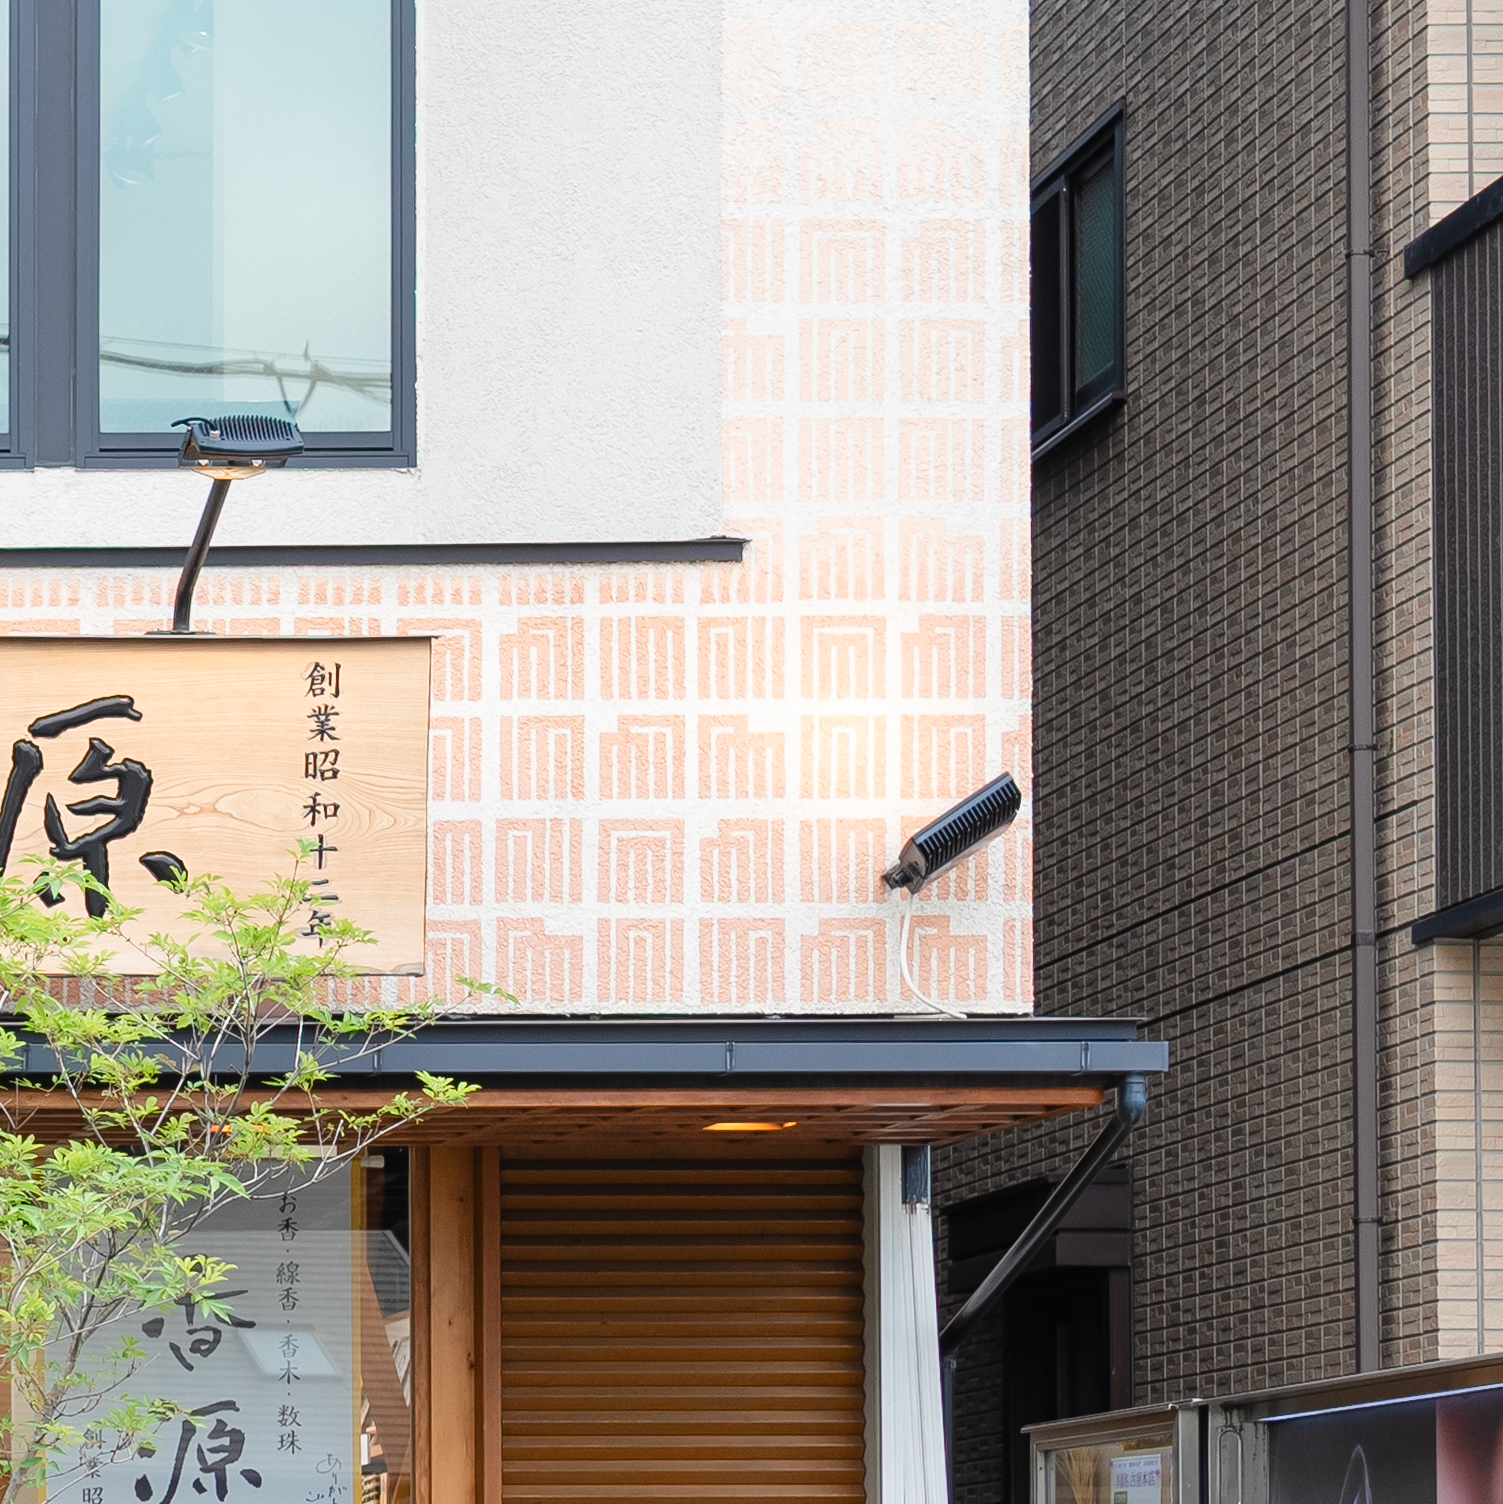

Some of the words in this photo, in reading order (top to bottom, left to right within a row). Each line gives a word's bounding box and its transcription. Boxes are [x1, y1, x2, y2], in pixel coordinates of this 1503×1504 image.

[301, 661, 342, 949] 創業昭和十二年
